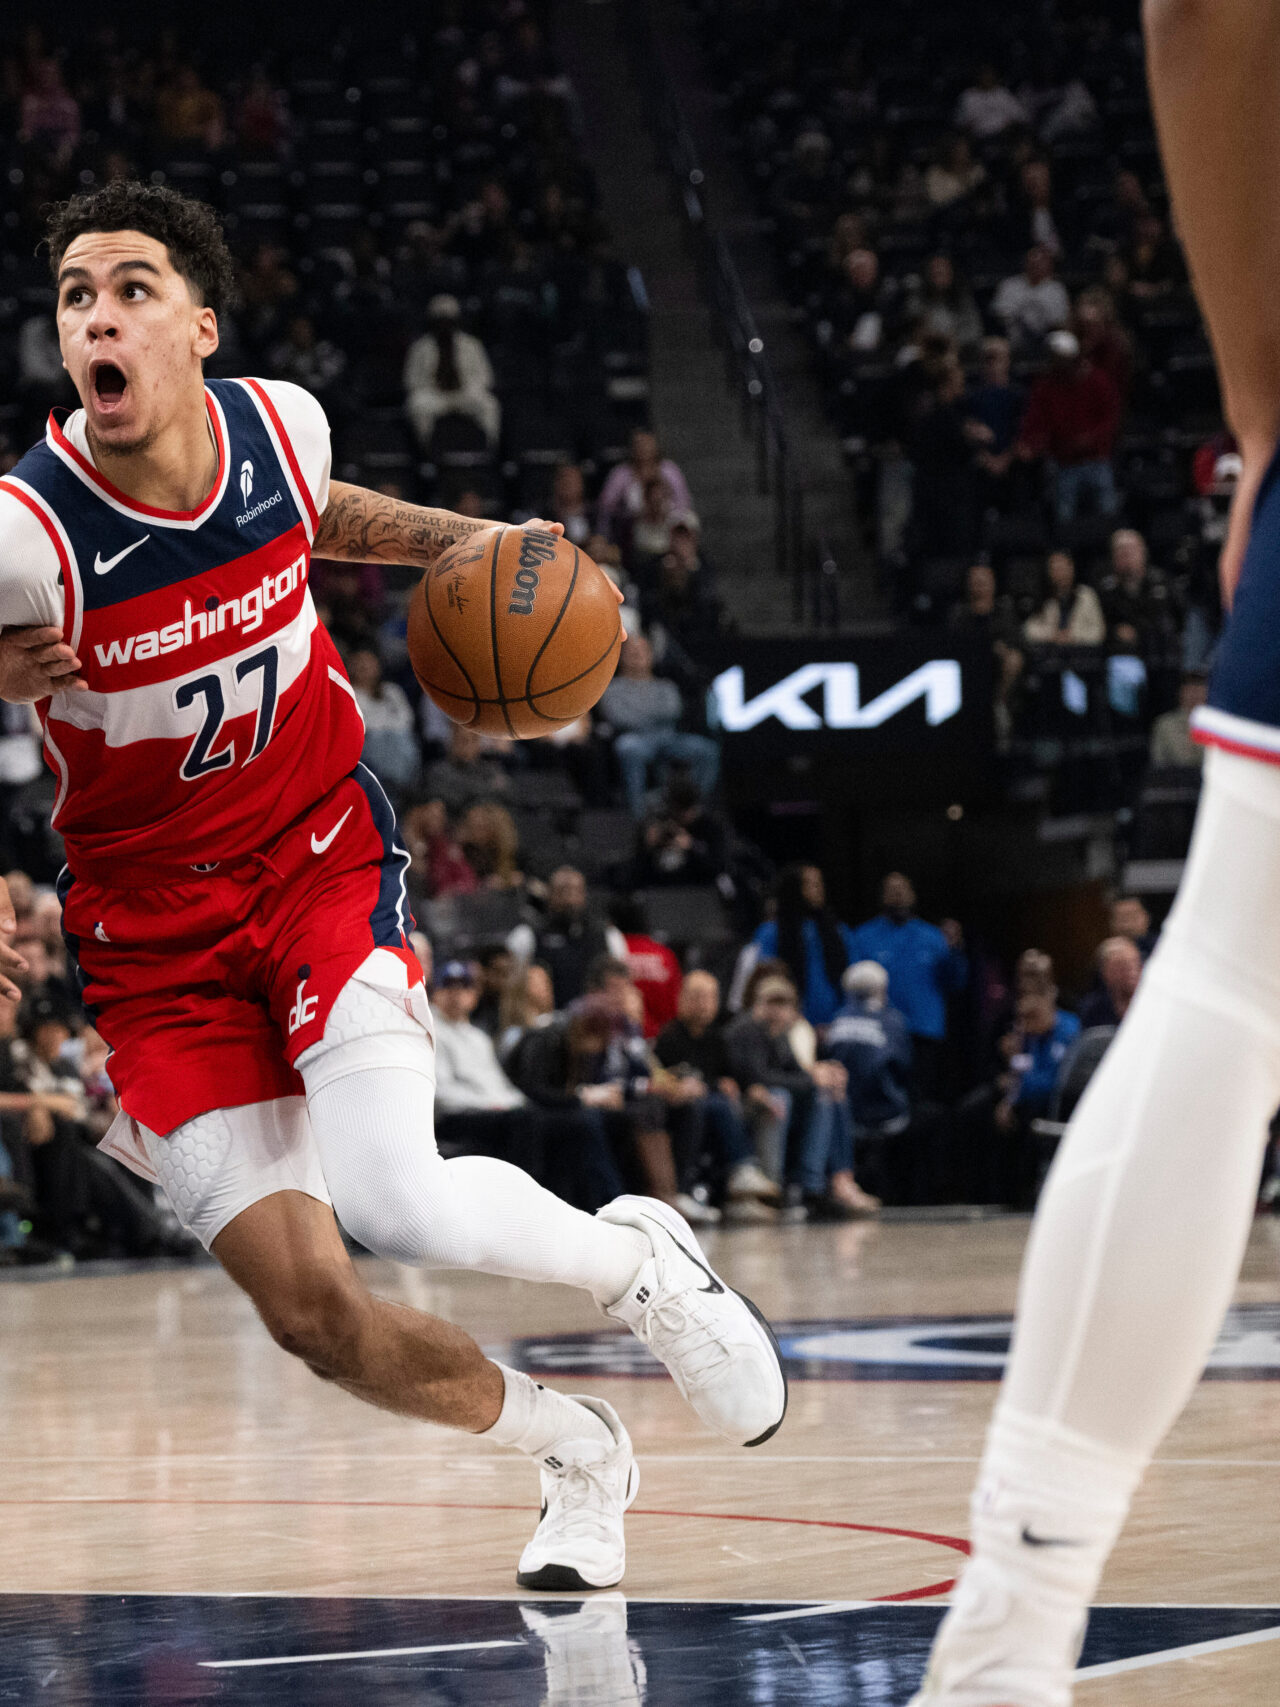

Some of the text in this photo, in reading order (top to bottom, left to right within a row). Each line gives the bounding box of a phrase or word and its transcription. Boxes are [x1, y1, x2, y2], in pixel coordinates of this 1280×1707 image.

[235, 489, 283, 528] Robinhood
[93, 553, 307, 668] washington
[173, 644, 280, 782] 27
